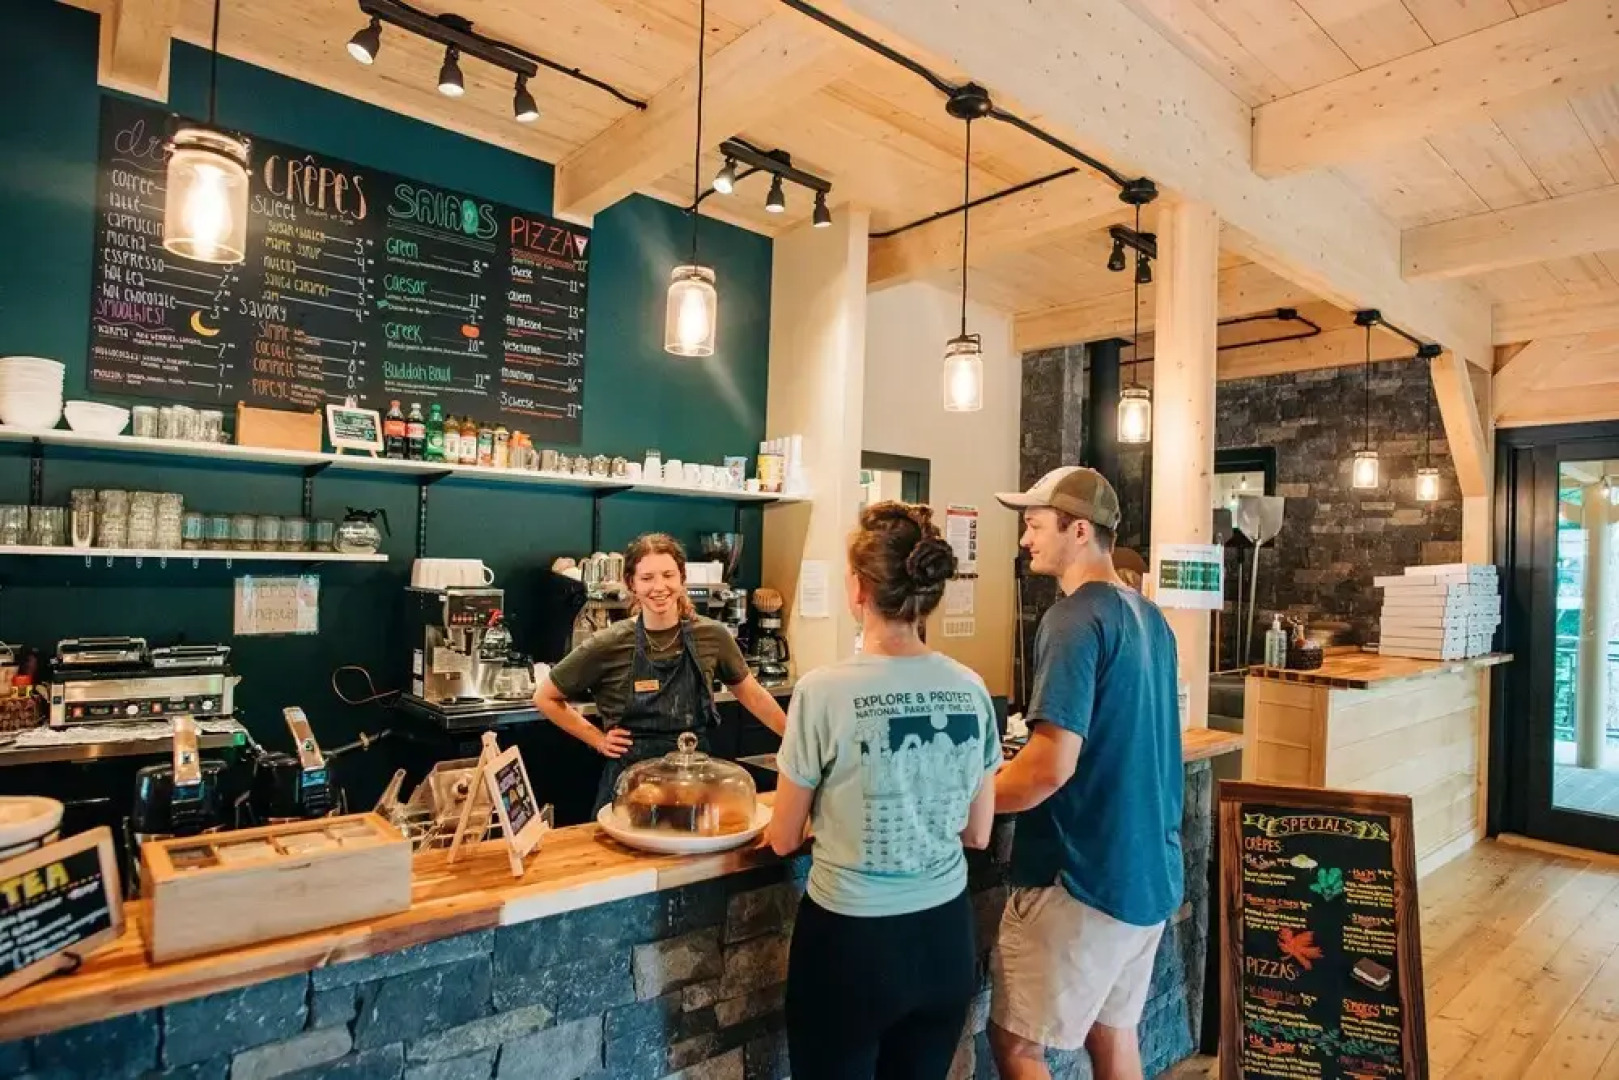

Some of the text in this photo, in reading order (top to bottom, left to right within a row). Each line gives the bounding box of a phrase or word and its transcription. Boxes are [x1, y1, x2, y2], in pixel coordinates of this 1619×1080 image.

[510, 216, 574, 259] PIZZA
[853, 689, 973, 710] EXPLORE & PROTECT
[855, 707, 901, 719] NATIONAL
[904, 705, 932, 715] PARKS
[1280, 817, 1354, 833] SPECIALS
[1, 862, 69, 906] TEA
